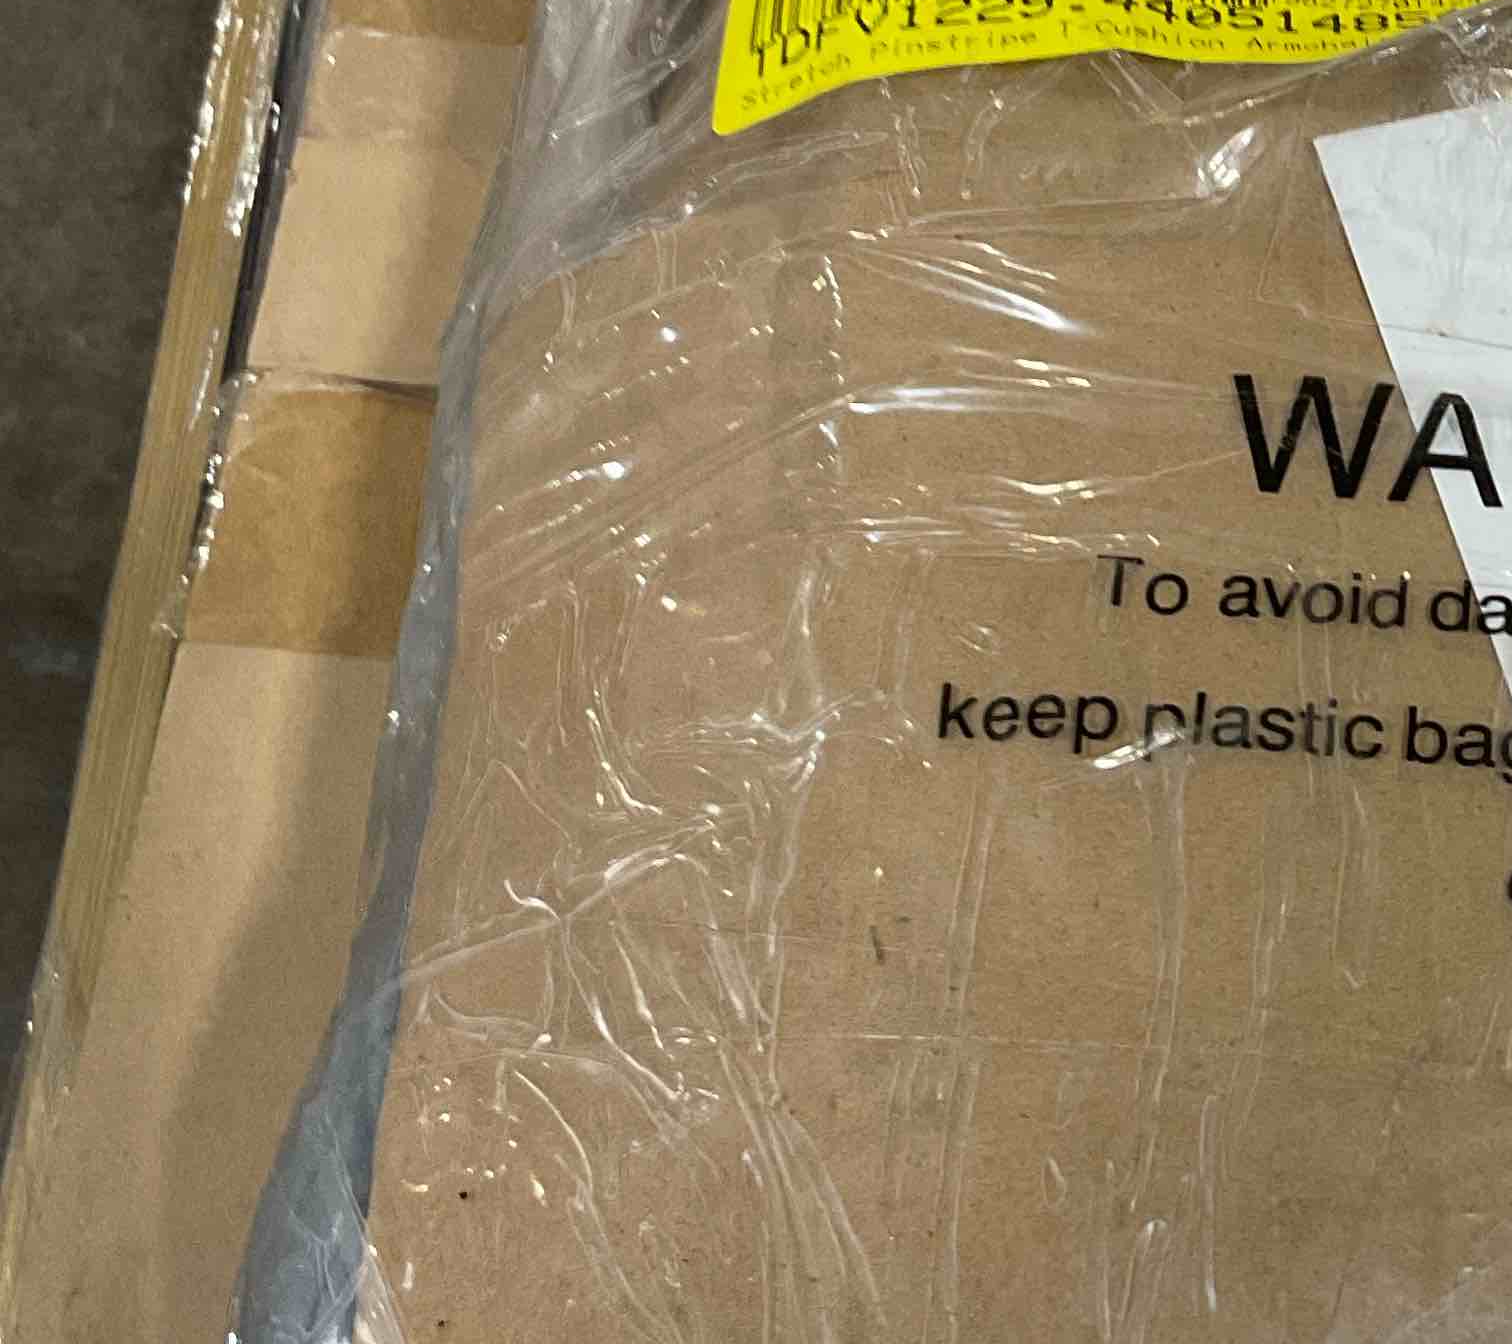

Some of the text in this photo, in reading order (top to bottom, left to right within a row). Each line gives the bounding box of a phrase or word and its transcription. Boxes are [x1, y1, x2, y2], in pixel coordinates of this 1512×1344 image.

[1098, 554, 1189, 617] To
[1218, 572, 1405, 629] avoid
[937, 682, 1119, 754] keep
[1143, 691, 1384, 763] plastic
